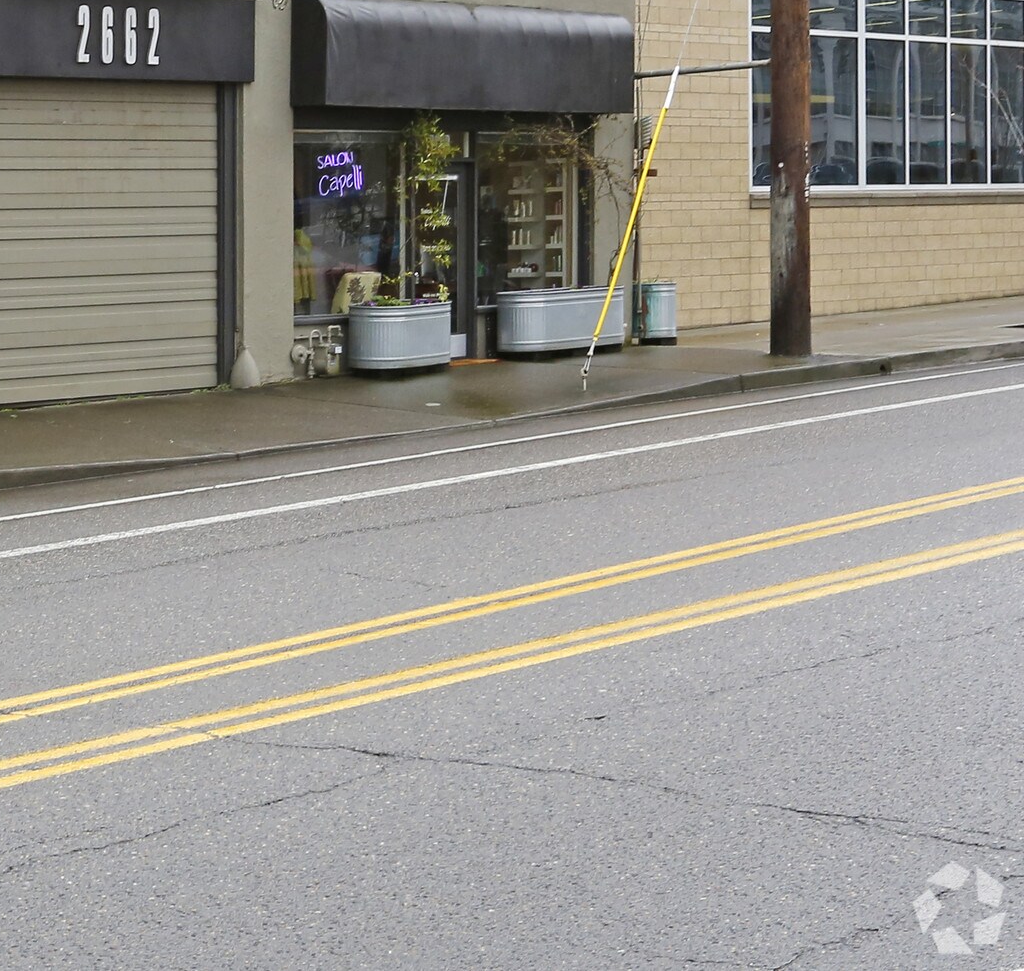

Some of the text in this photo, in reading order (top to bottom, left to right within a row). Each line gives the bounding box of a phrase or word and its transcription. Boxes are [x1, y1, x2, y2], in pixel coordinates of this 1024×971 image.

[77, 4, 160, 66] 2662
[317, 151, 354, 170] SALON
[318, 164, 363, 198] Capelli
